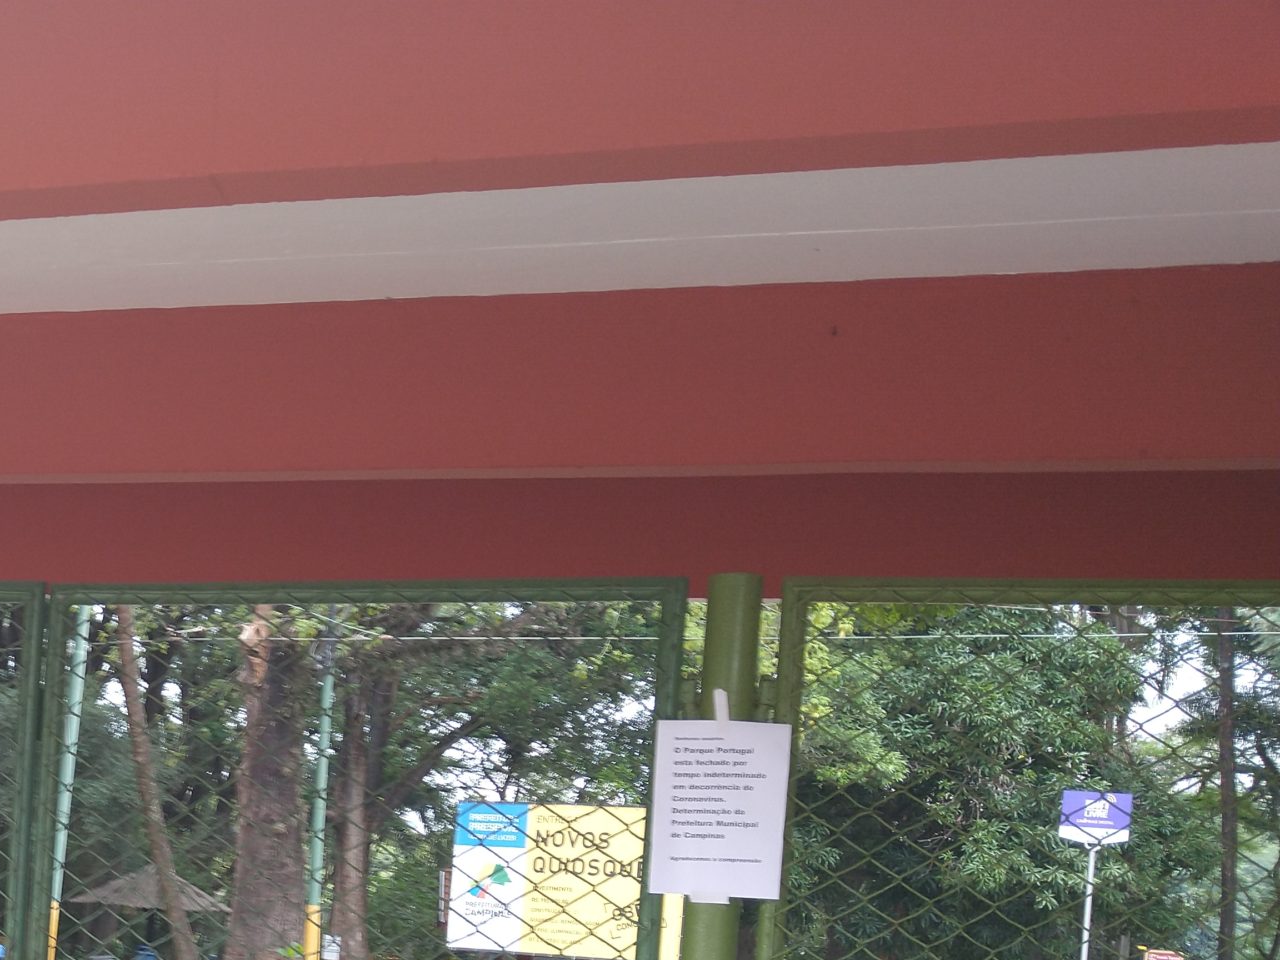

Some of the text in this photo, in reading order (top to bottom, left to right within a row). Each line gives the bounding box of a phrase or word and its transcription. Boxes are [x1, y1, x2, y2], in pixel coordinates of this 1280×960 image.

[684, 747, 715, 755] Parque
[717, 747, 755, 756] Portugal
[704, 771, 767, 779] indeterminado
[671, 819, 759, 829] Prefeitura Municipal
[536, 829, 610, 849] NOVOS
[684, 832, 725, 840] Campinas
[533, 856, 644, 879] QUIOSQUE
